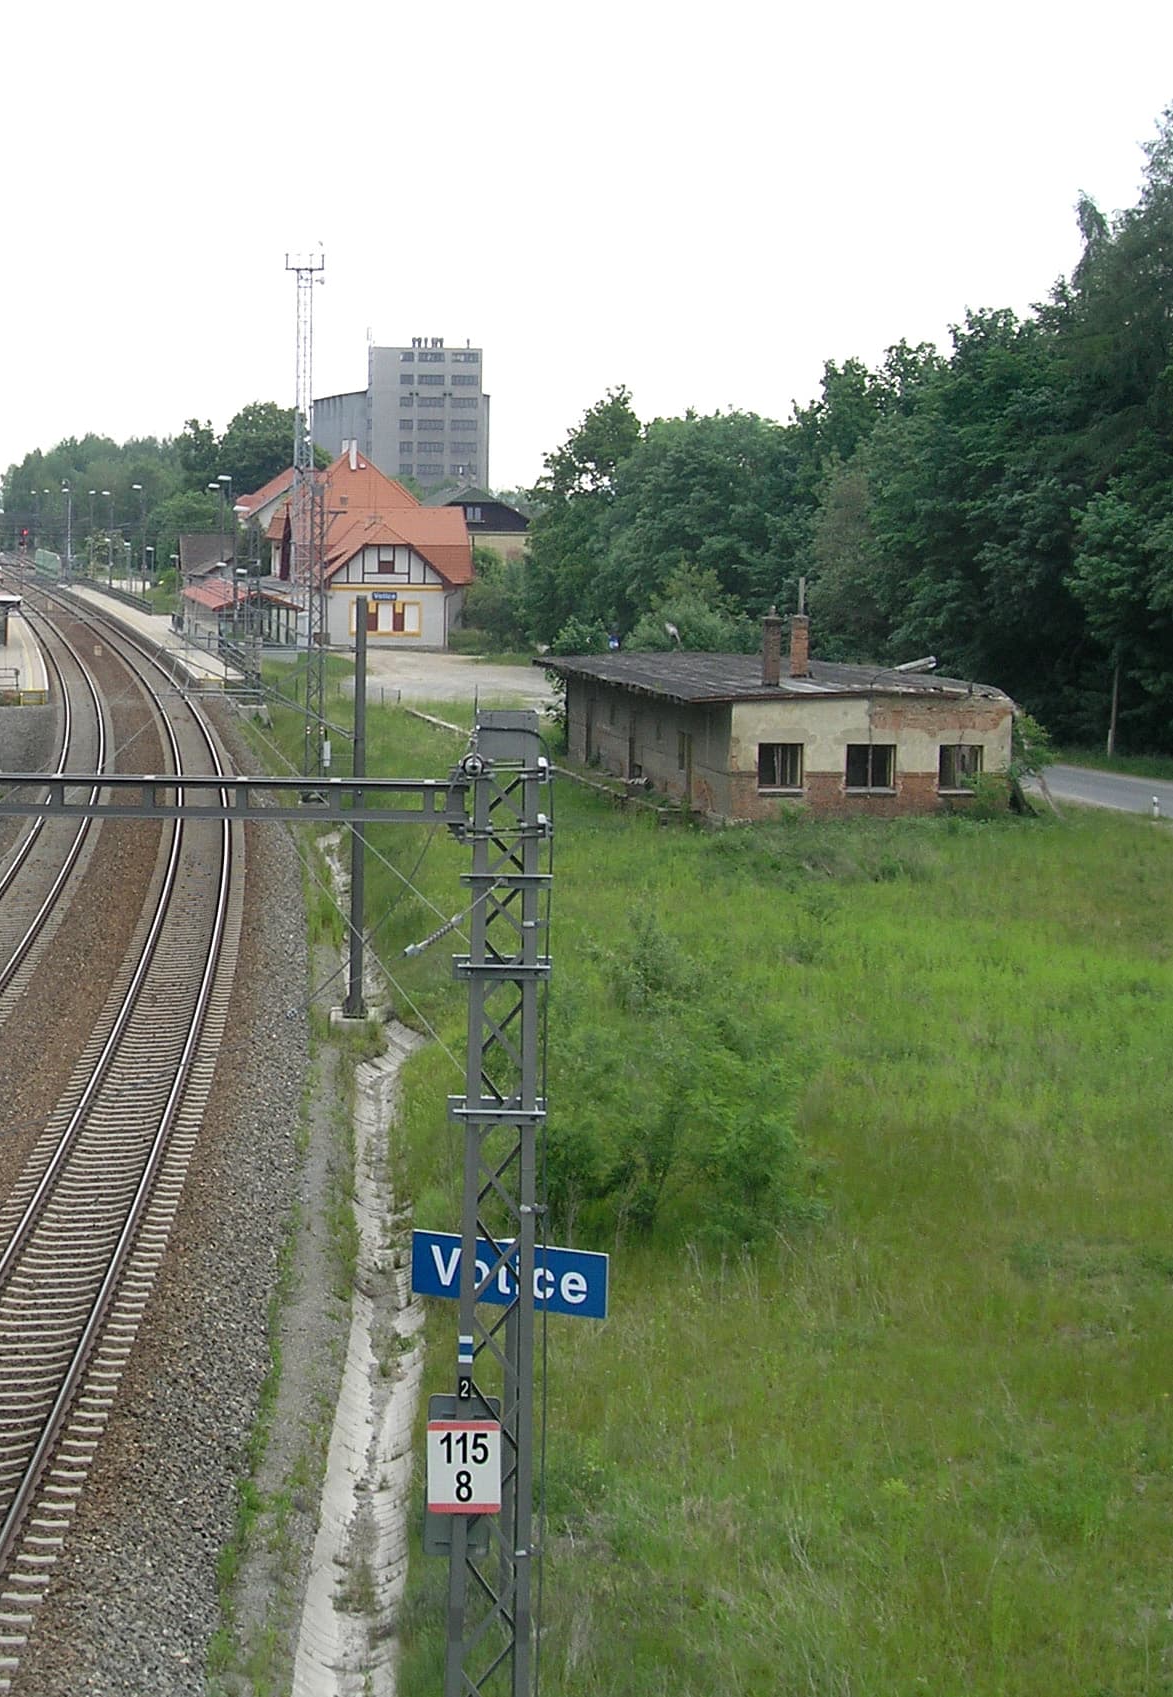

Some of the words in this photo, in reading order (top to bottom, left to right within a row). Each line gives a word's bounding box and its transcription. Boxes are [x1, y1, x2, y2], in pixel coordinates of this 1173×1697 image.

[460, 1380, 469, 1397] 2
[440, 1432, 489, 1464] 115
[455, 1470, 473, 1502] 8
